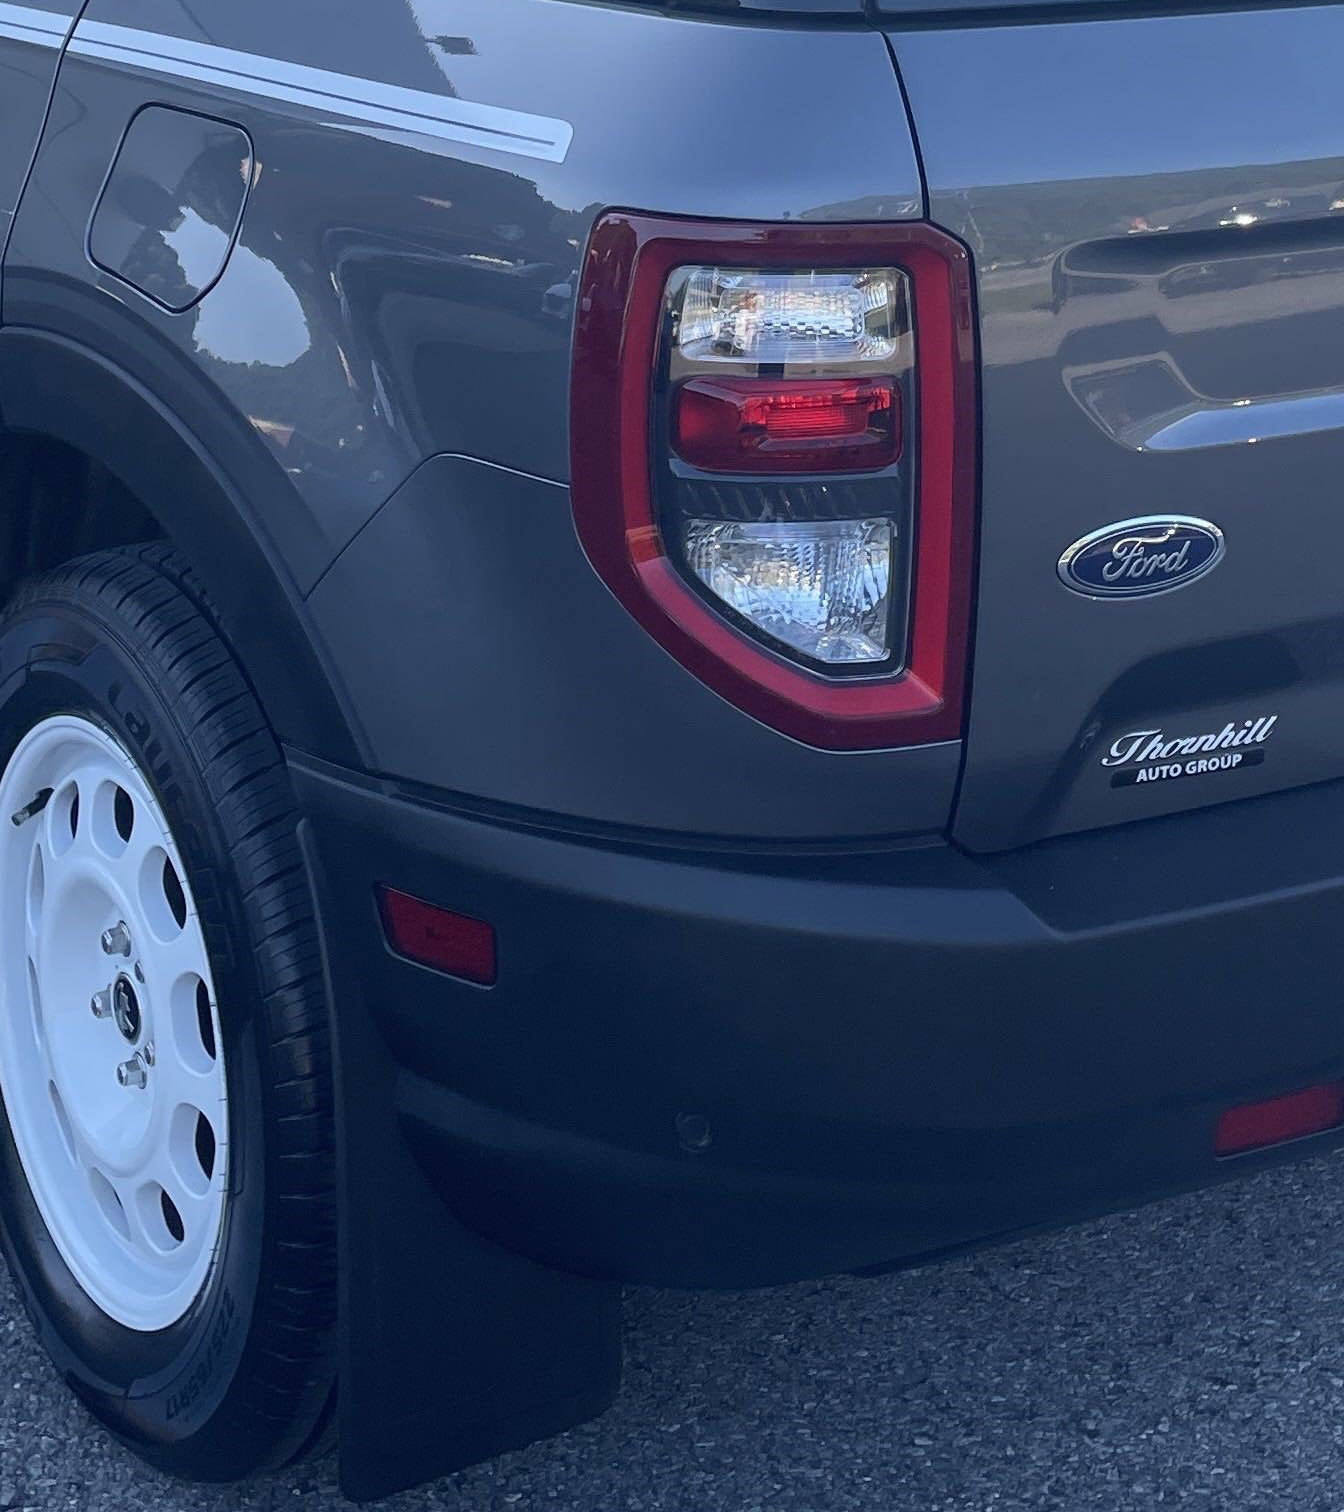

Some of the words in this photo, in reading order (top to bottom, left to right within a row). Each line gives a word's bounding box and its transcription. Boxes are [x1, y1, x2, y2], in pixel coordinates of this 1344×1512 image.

[1102, 535, 1191, 582] Ford
[1101, 715, 1279, 767] Thornhill
[1135, 762, 1183, 784] AUTO
[1184, 753, 1244, 776] GROUP
